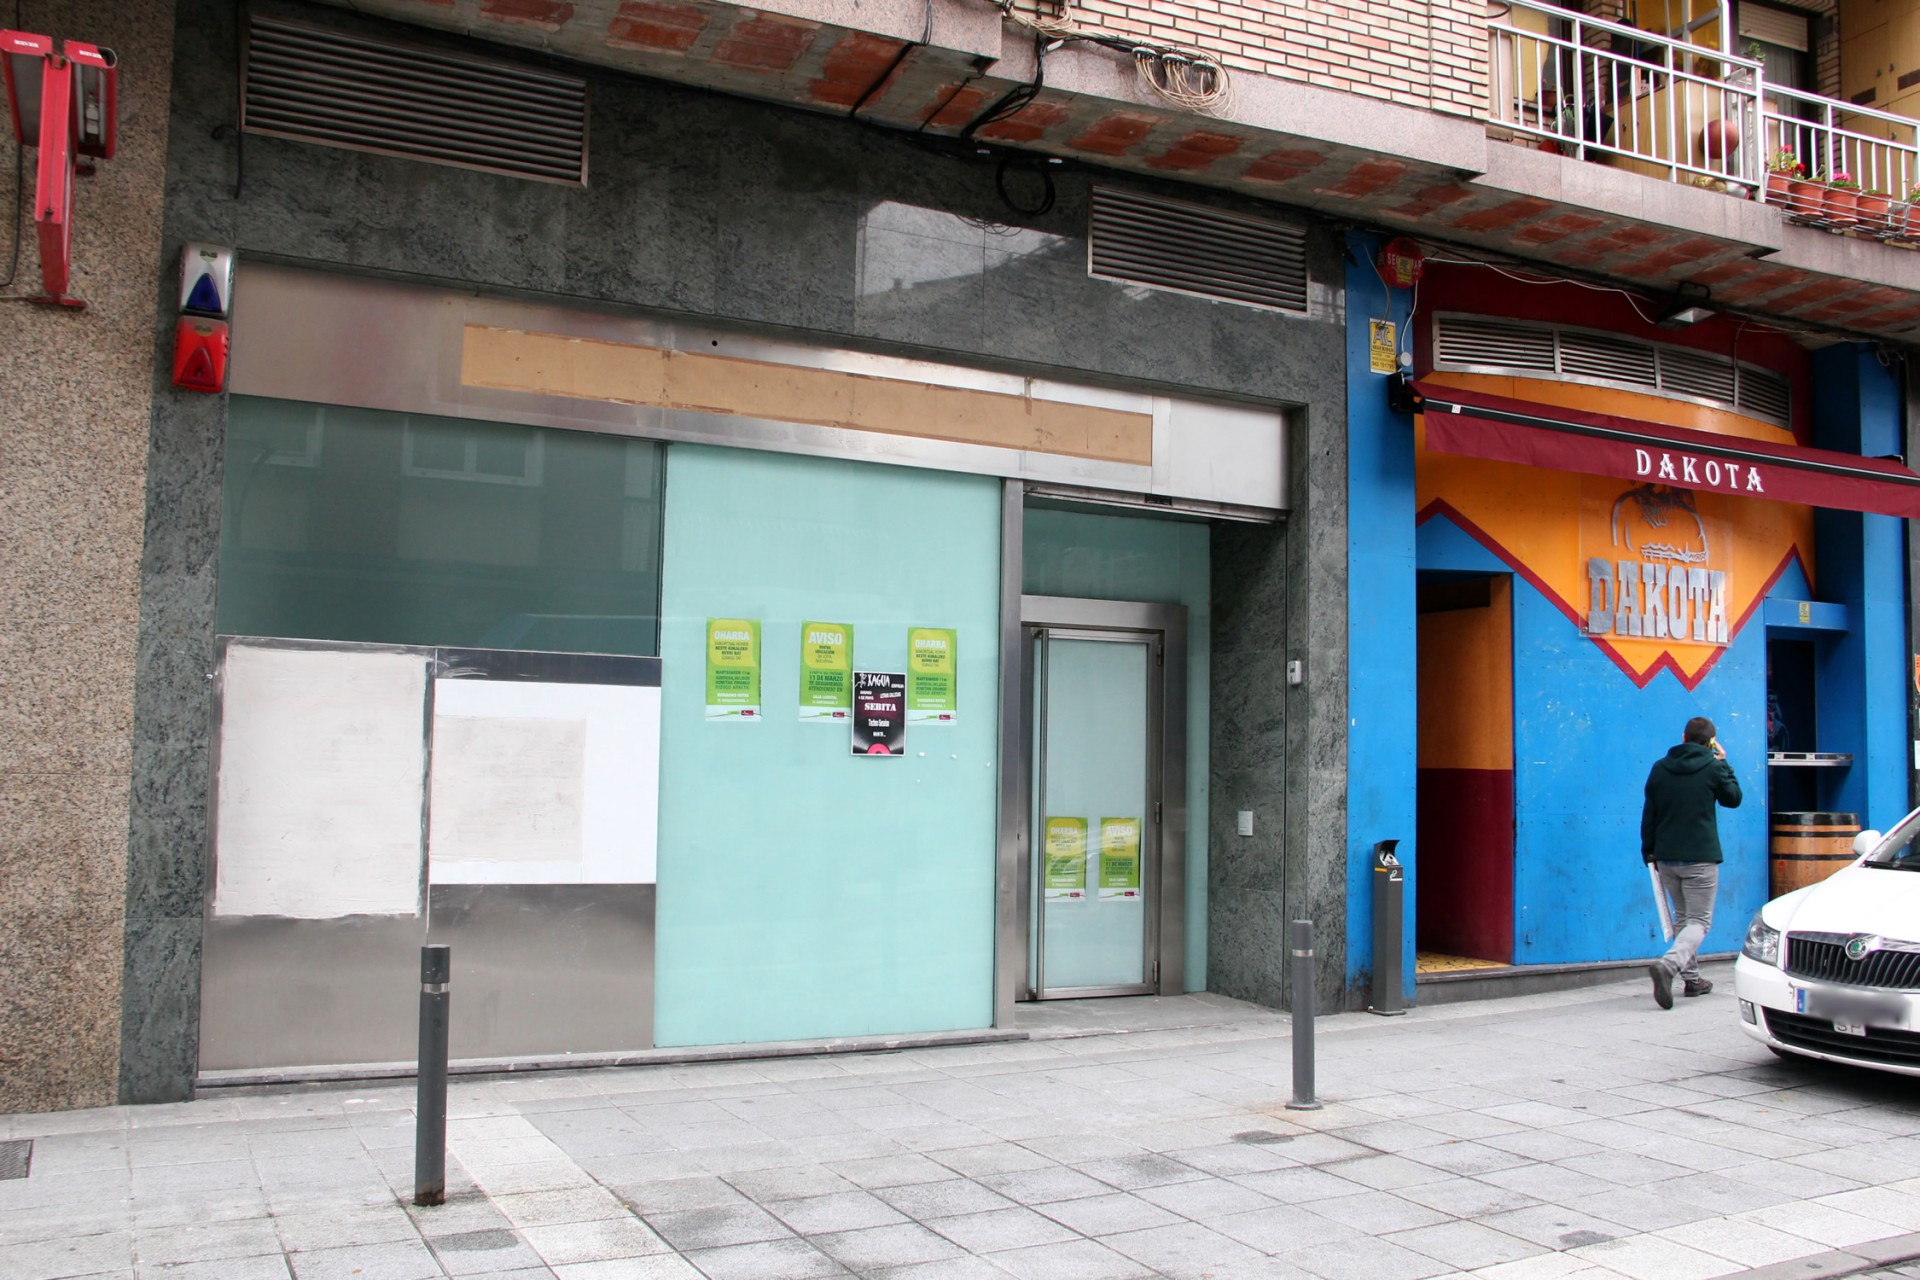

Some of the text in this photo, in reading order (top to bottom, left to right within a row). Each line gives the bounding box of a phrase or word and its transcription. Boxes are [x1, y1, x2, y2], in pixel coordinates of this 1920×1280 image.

[1635, 448, 1765, 493] DAKOTA
[1588, 557, 1729, 644] DAKOTA
[714, 630, 750, 640] OHARRA
[809, 632, 843, 645] AVISO
[915, 639, 947, 649] OHARRA
[864, 702, 896, 711] SEBITA
[1107, 826, 1133, 836] AVISO
